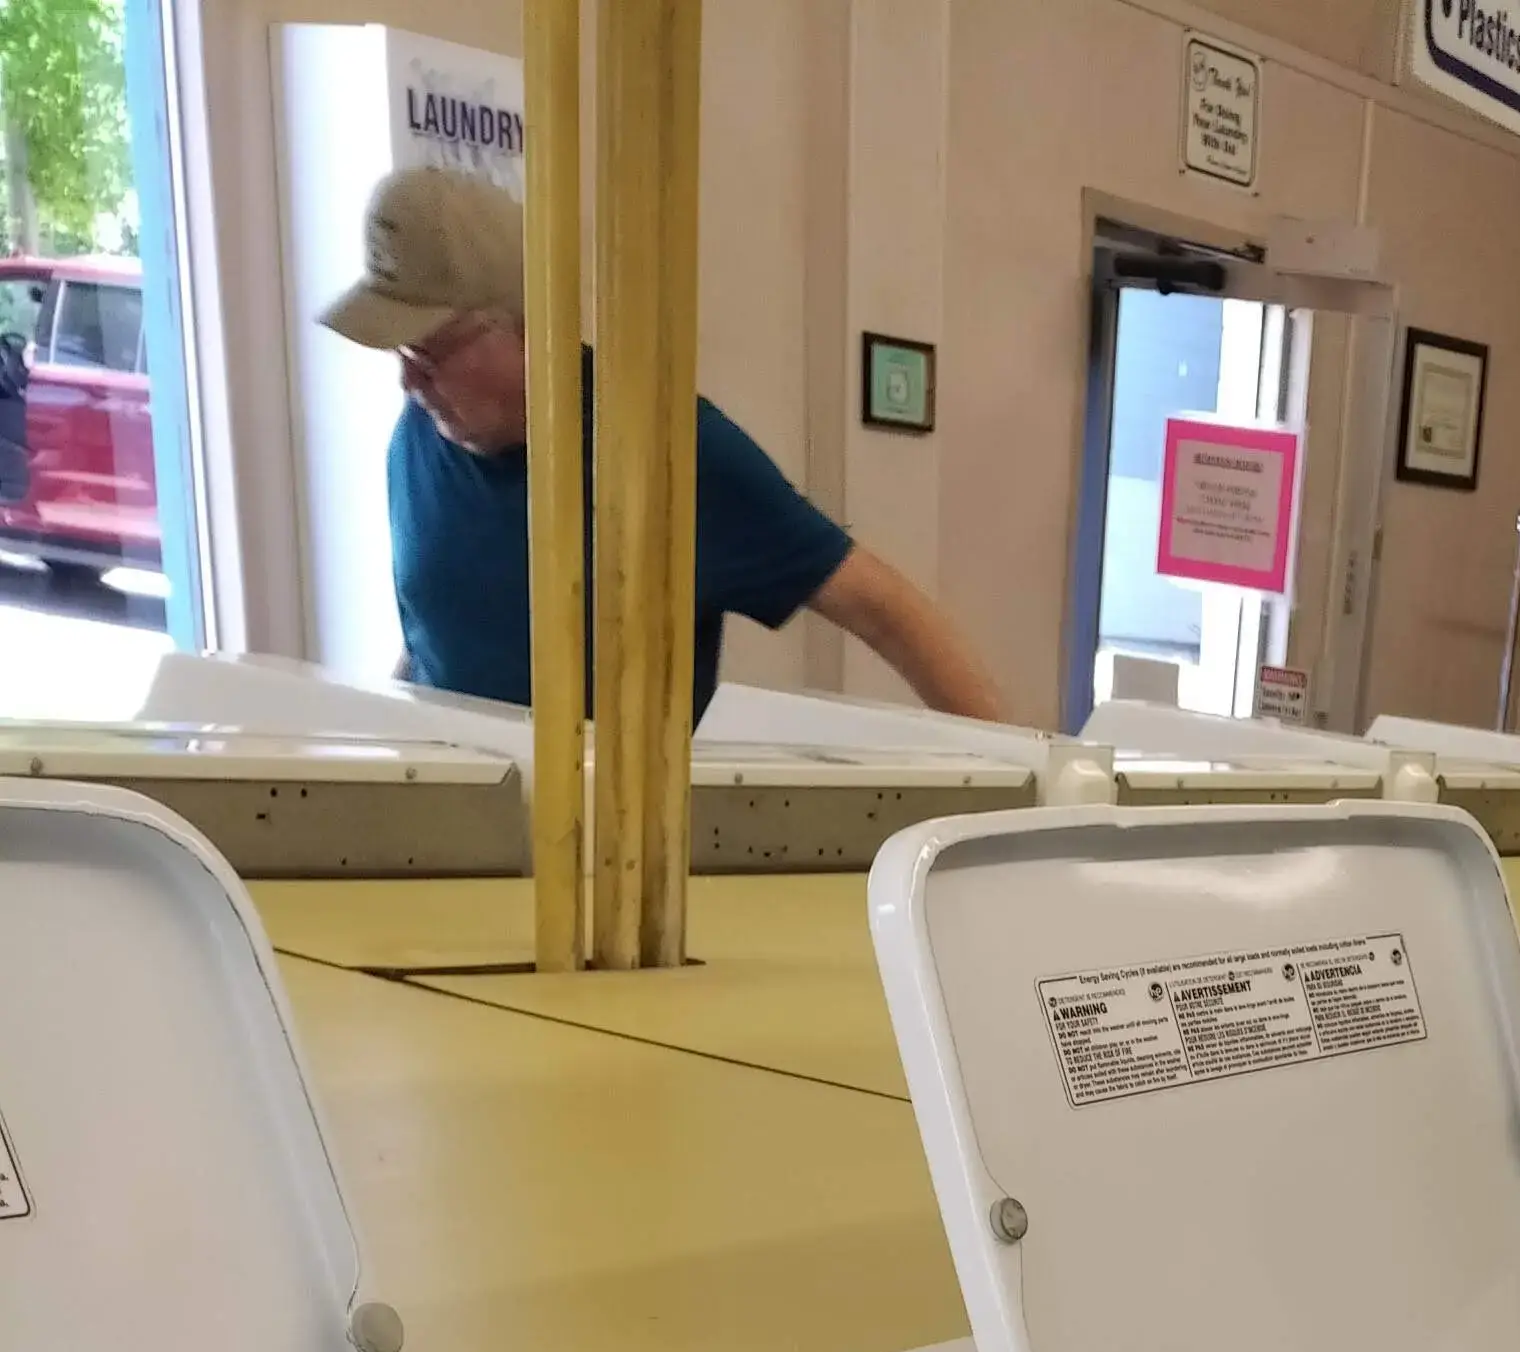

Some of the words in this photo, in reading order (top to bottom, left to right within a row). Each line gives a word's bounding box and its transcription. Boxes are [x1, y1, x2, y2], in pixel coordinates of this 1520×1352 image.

[407, 86, 524, 155] LAUNDRY
[1311, 964, 1362, 981] ADVERTENCIA
[1181, 980, 1252, 1001] AVERTISSEMENT
[1060, 1002, 1108, 1019] WARNING
